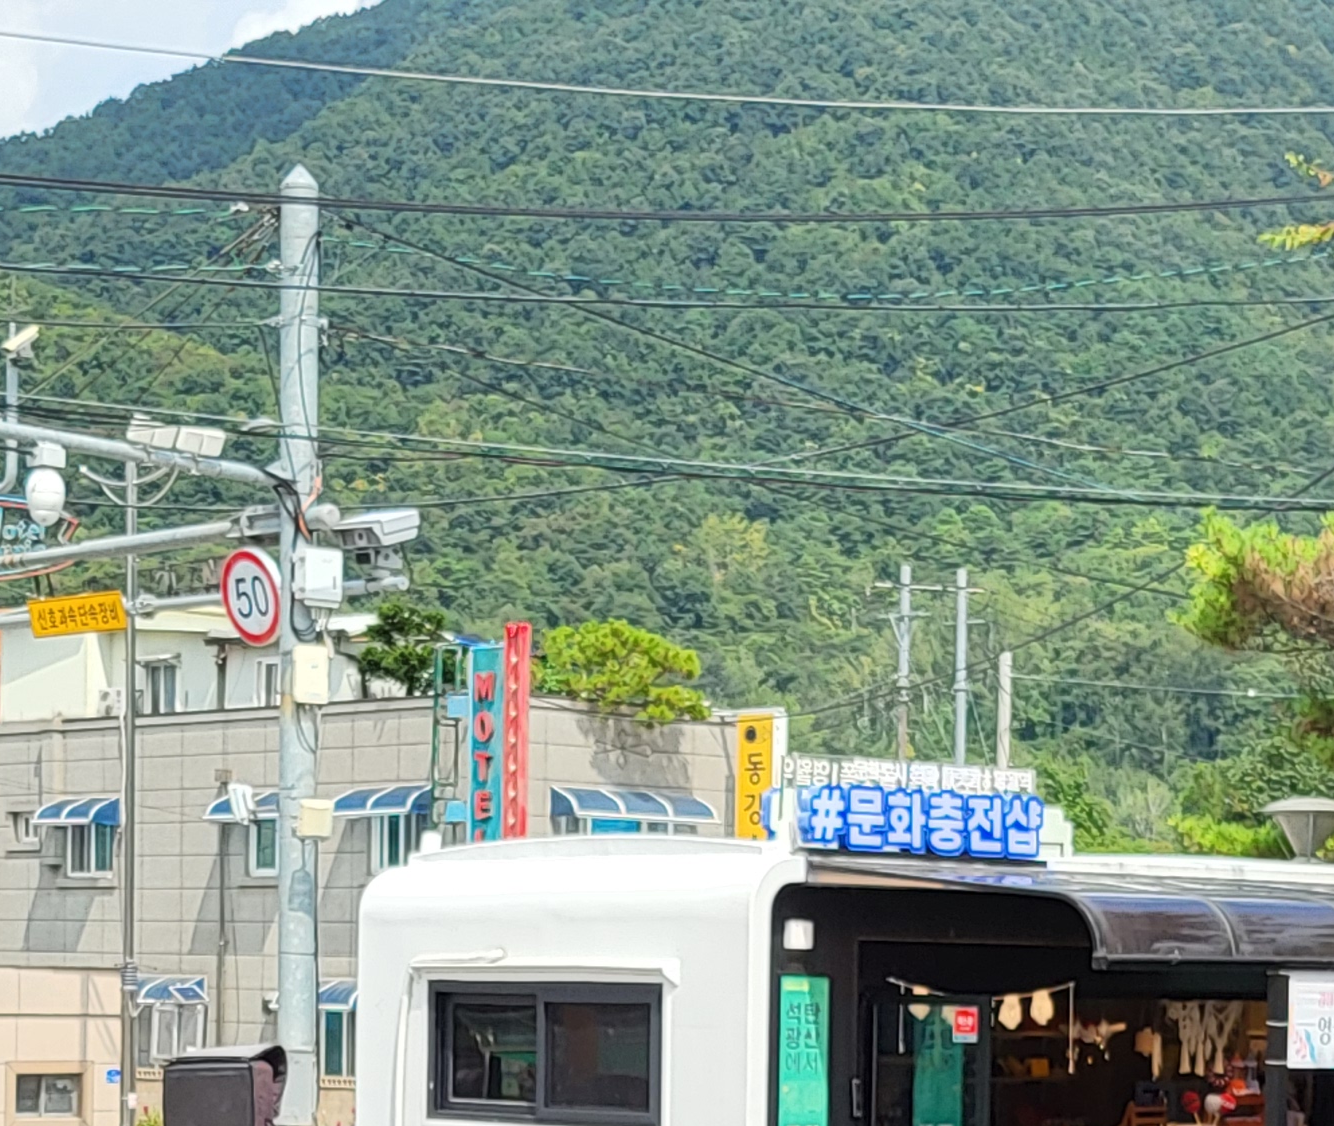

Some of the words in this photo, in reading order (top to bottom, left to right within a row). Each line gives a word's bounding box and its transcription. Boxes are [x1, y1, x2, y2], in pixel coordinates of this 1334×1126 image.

[37, 601, 121, 631] 신호과속단속장비
[234, 575, 270, 618] 50
[810, 787, 1042, 858] #문화충전샵
